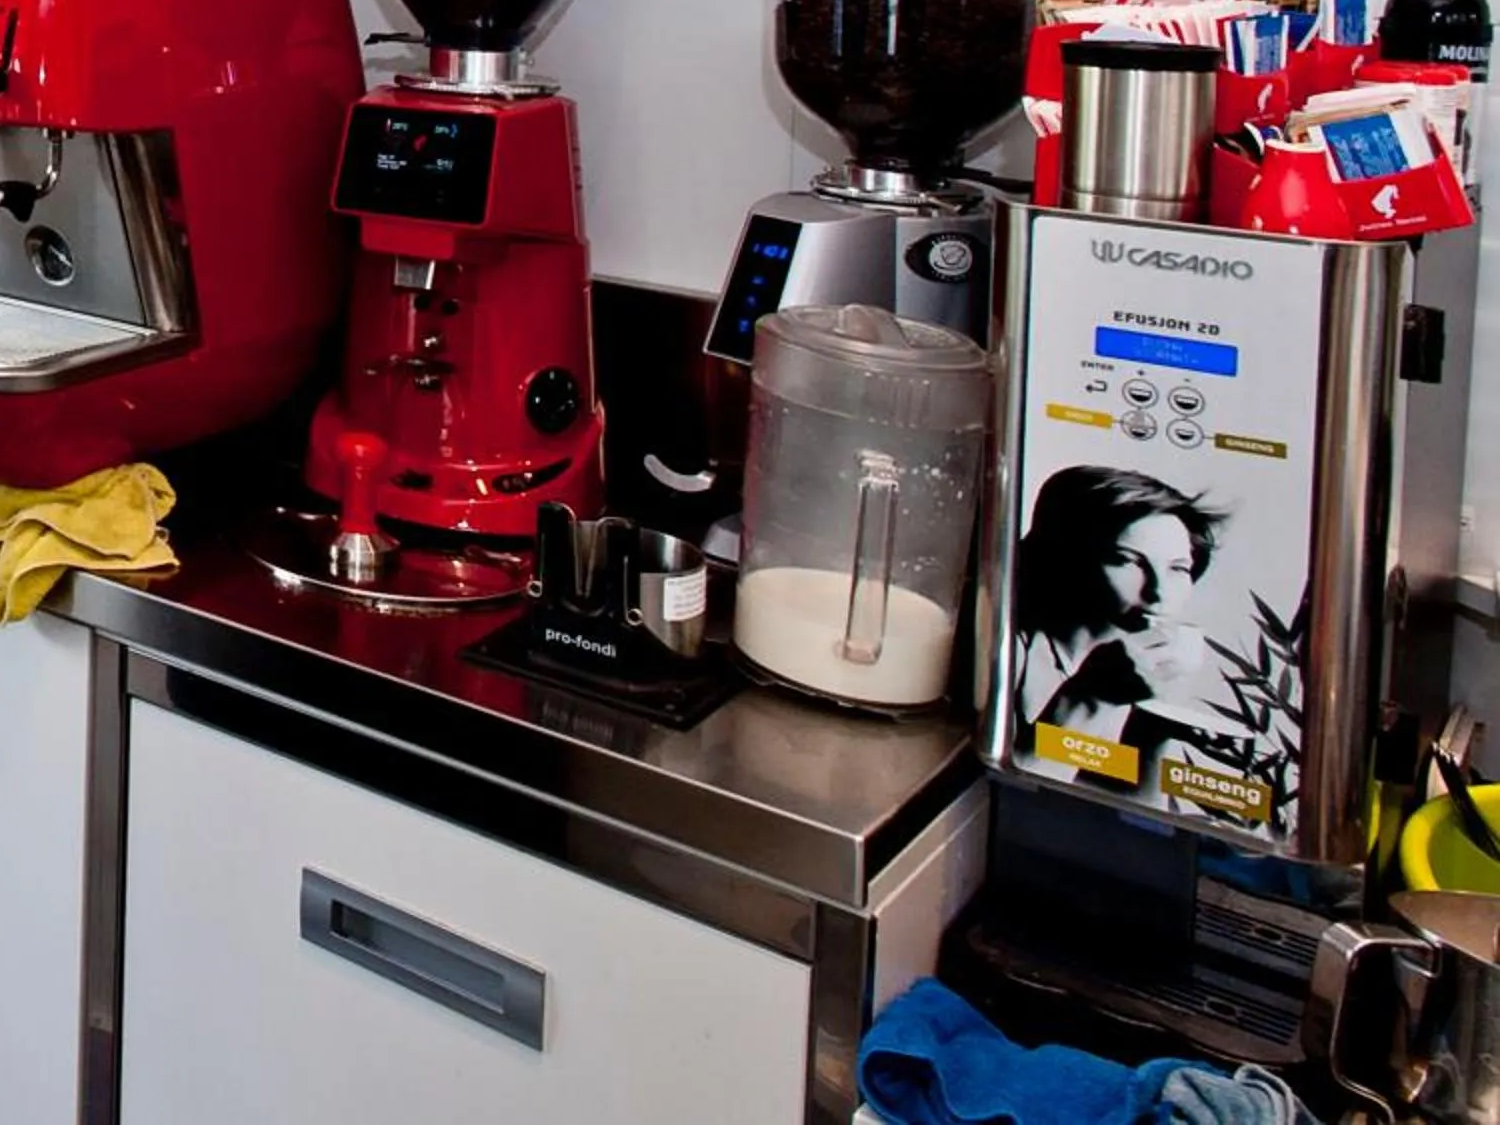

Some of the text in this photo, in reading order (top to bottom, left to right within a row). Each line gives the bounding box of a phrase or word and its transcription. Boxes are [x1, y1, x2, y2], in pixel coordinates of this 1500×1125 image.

[545, 627, 617, 658] pro-fondi
[1061, 735, 1110, 759] orzo
[1169, 766, 1262, 807] ginseng
